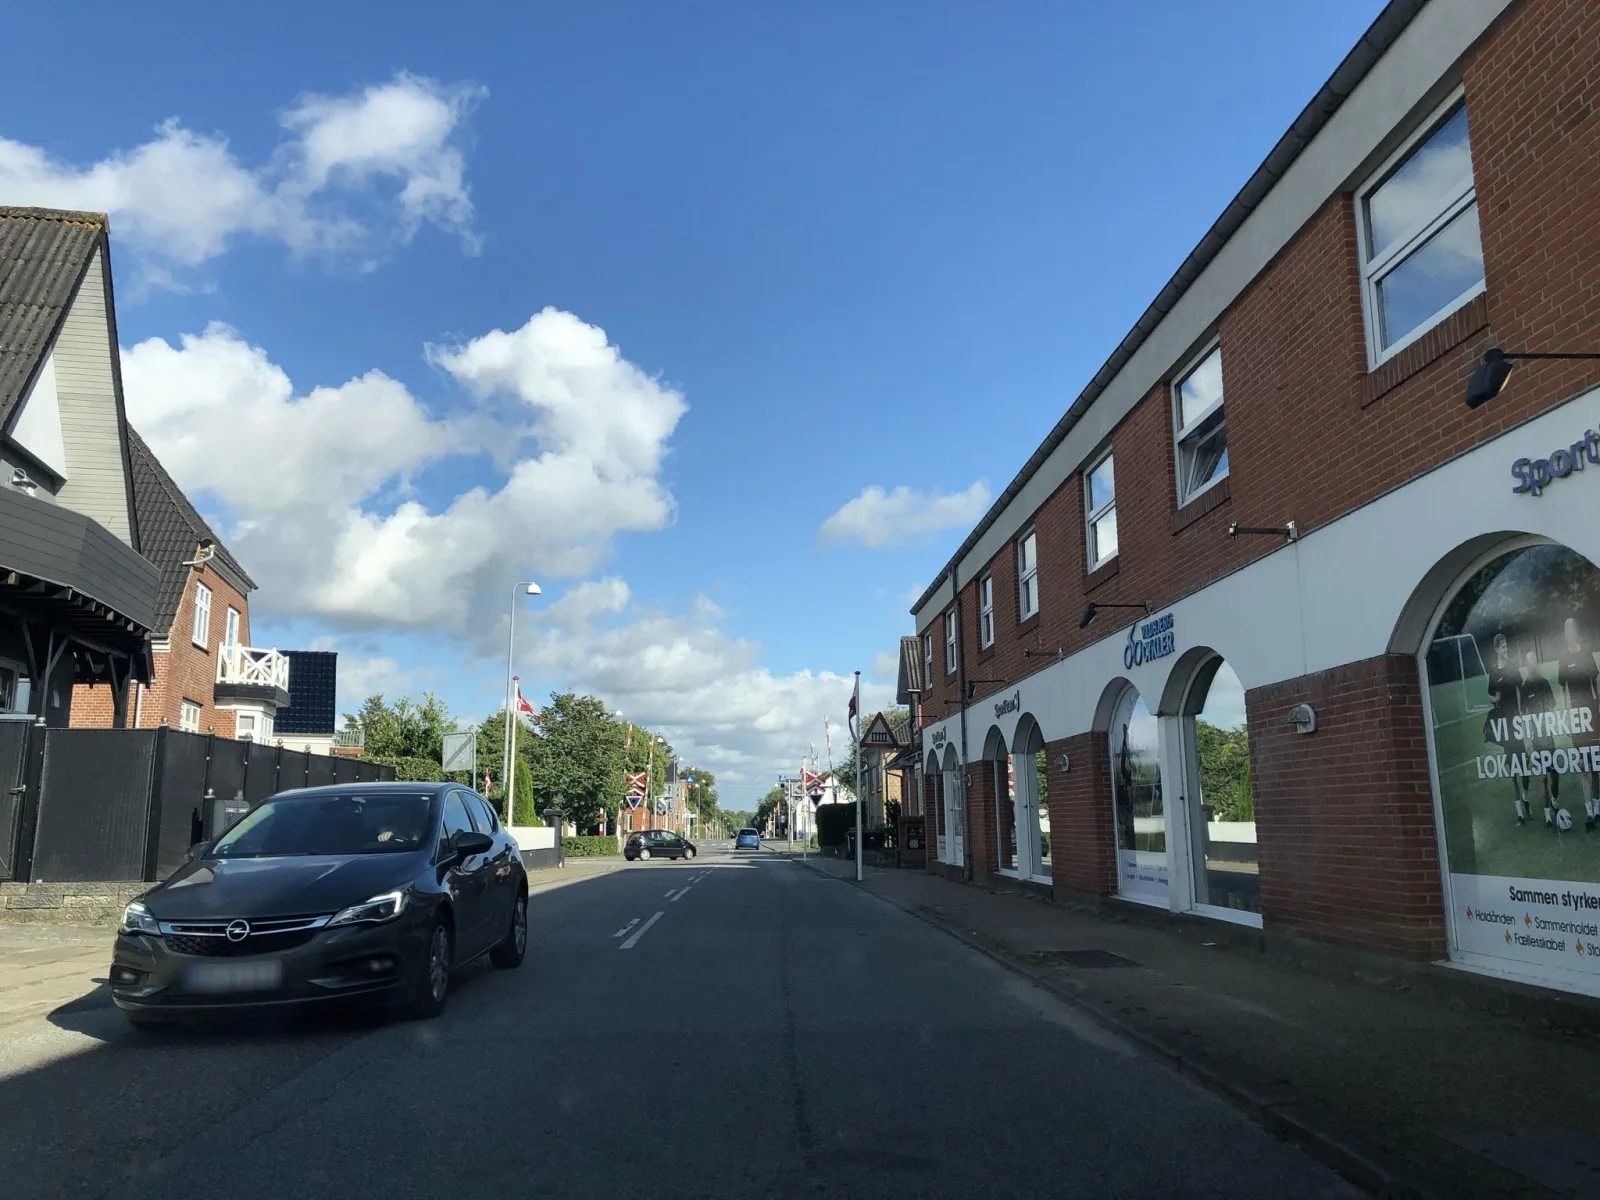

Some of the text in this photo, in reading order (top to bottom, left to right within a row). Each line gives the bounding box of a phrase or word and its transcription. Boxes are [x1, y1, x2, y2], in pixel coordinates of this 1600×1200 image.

[1511, 422, 1600, 497] Sport
[1490, 706, 1594, 742] VI STYRKER
[1476, 745, 1600, 779] LOKALSPORTE
[1509, 885, 1559, 906] Sammen
[1535, 916, 1598, 937] Sammenholdet
[1514, 932, 1566, 952] Fællesskabet
